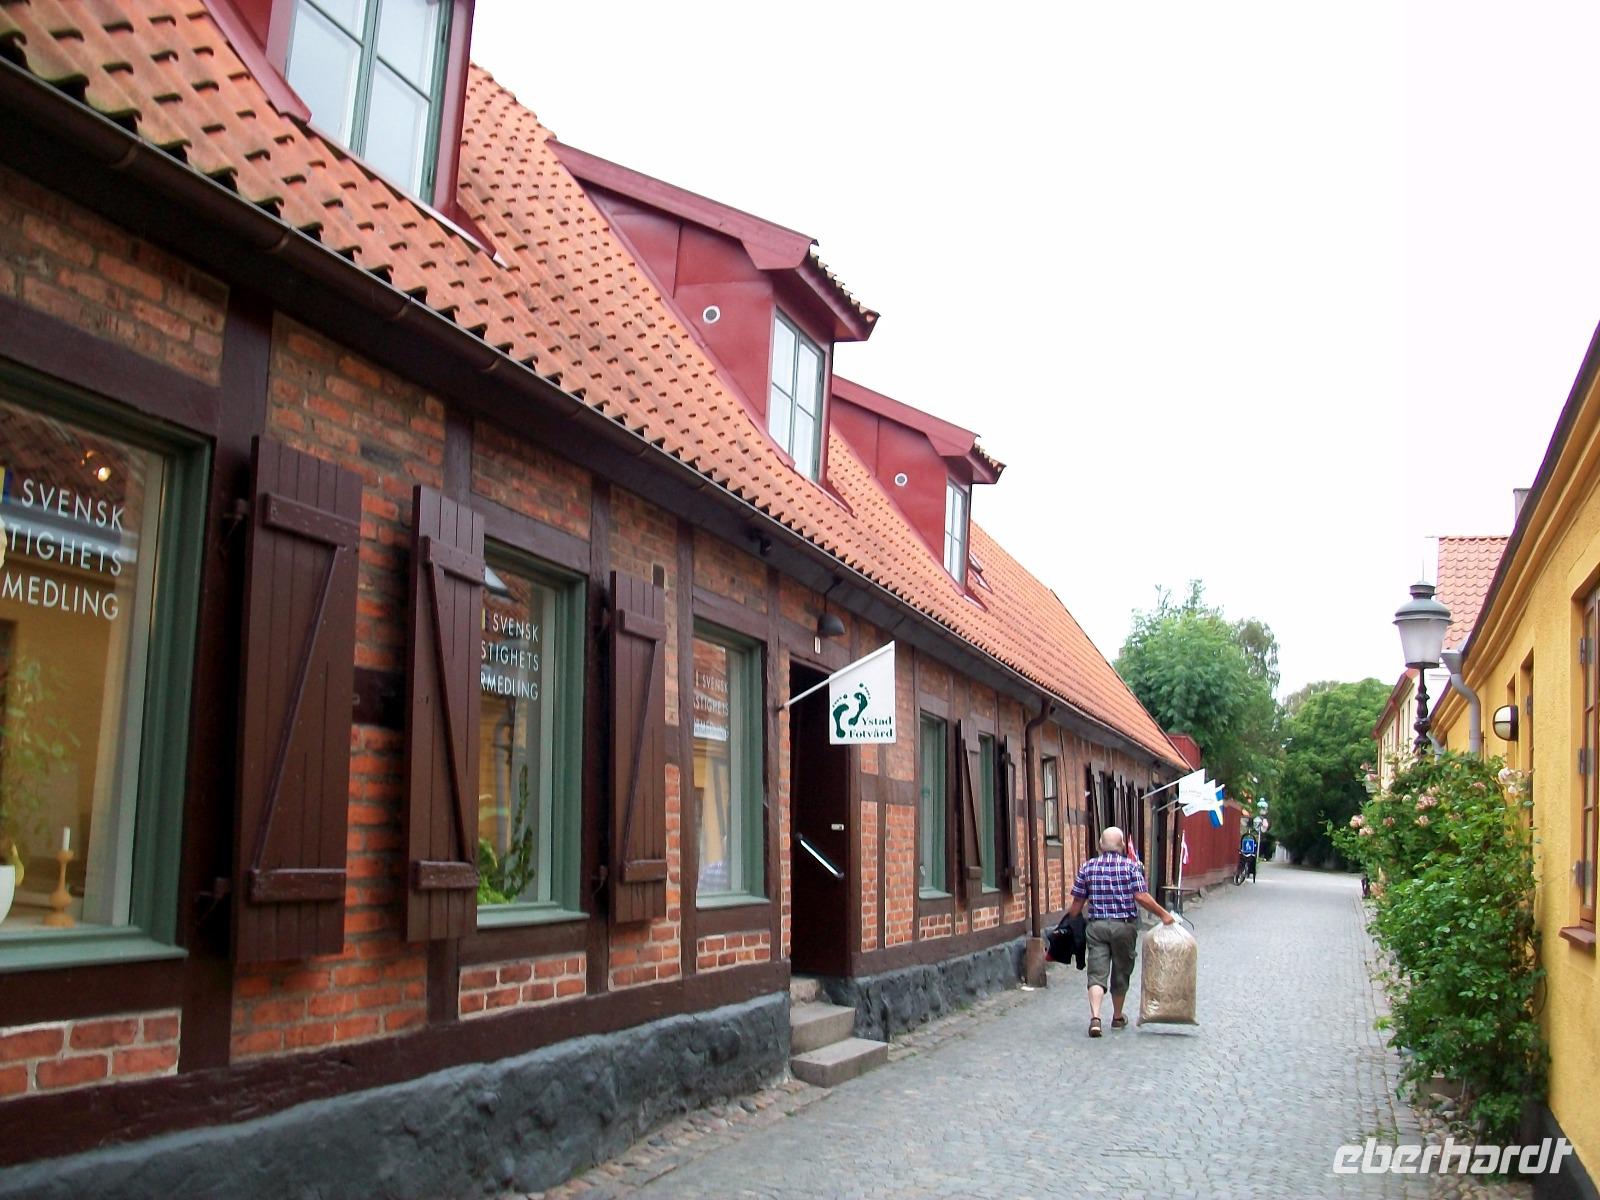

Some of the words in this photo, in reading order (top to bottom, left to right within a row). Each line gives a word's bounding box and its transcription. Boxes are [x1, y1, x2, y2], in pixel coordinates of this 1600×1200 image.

[21, 478, 125, 533] SVENSK
[9, 523, 122, 577] TIGHETS
[1, 570, 119, 620] MEDLING
[492, 613, 539, 643] SVENSK
[481, 640, 539, 672] STIGHETS
[480, 671, 539, 700] RMEDLING
[849, 728, 893, 738] Fotvård
[862, 716, 892, 726] Ystad
